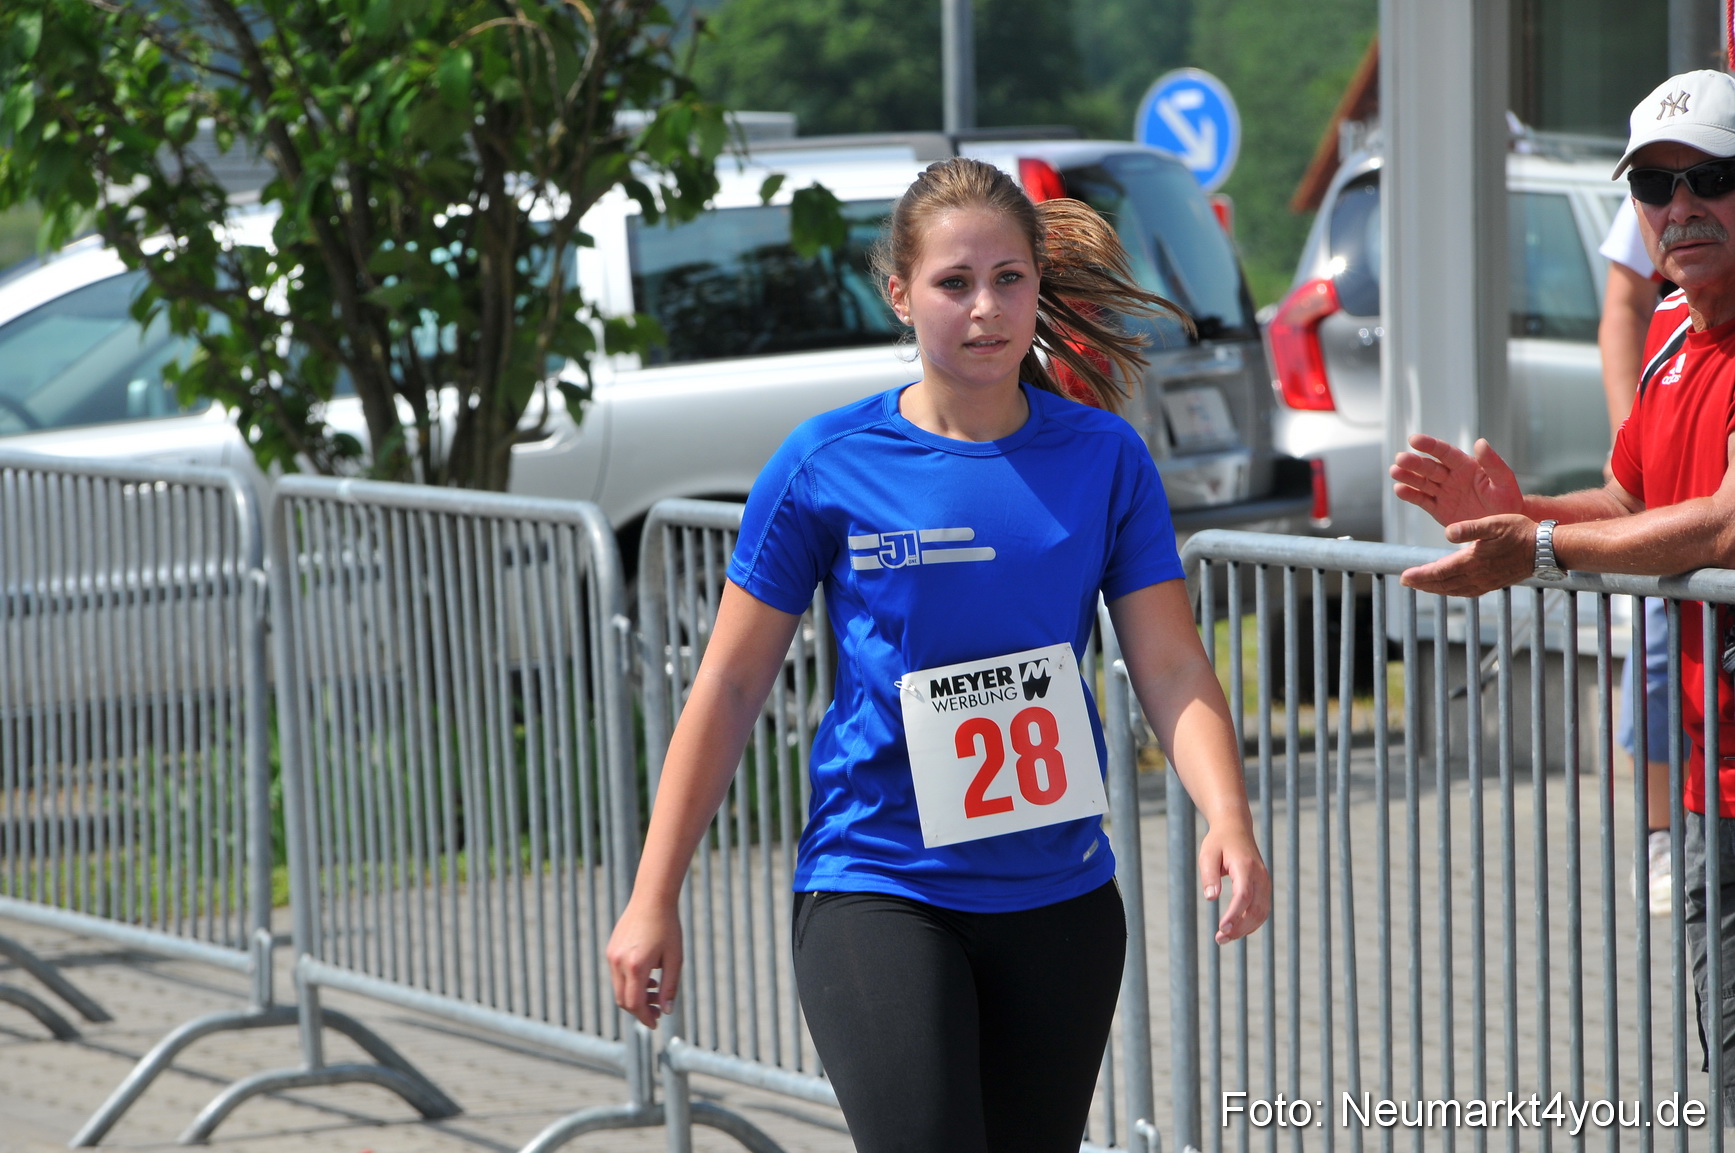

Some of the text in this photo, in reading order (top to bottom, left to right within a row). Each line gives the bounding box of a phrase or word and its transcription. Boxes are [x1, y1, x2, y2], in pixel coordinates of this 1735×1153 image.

[930, 666, 1015, 699] MEYER
[932, 686, 1018, 713] WERBUNG
[954, 706, 1068, 819] 28
